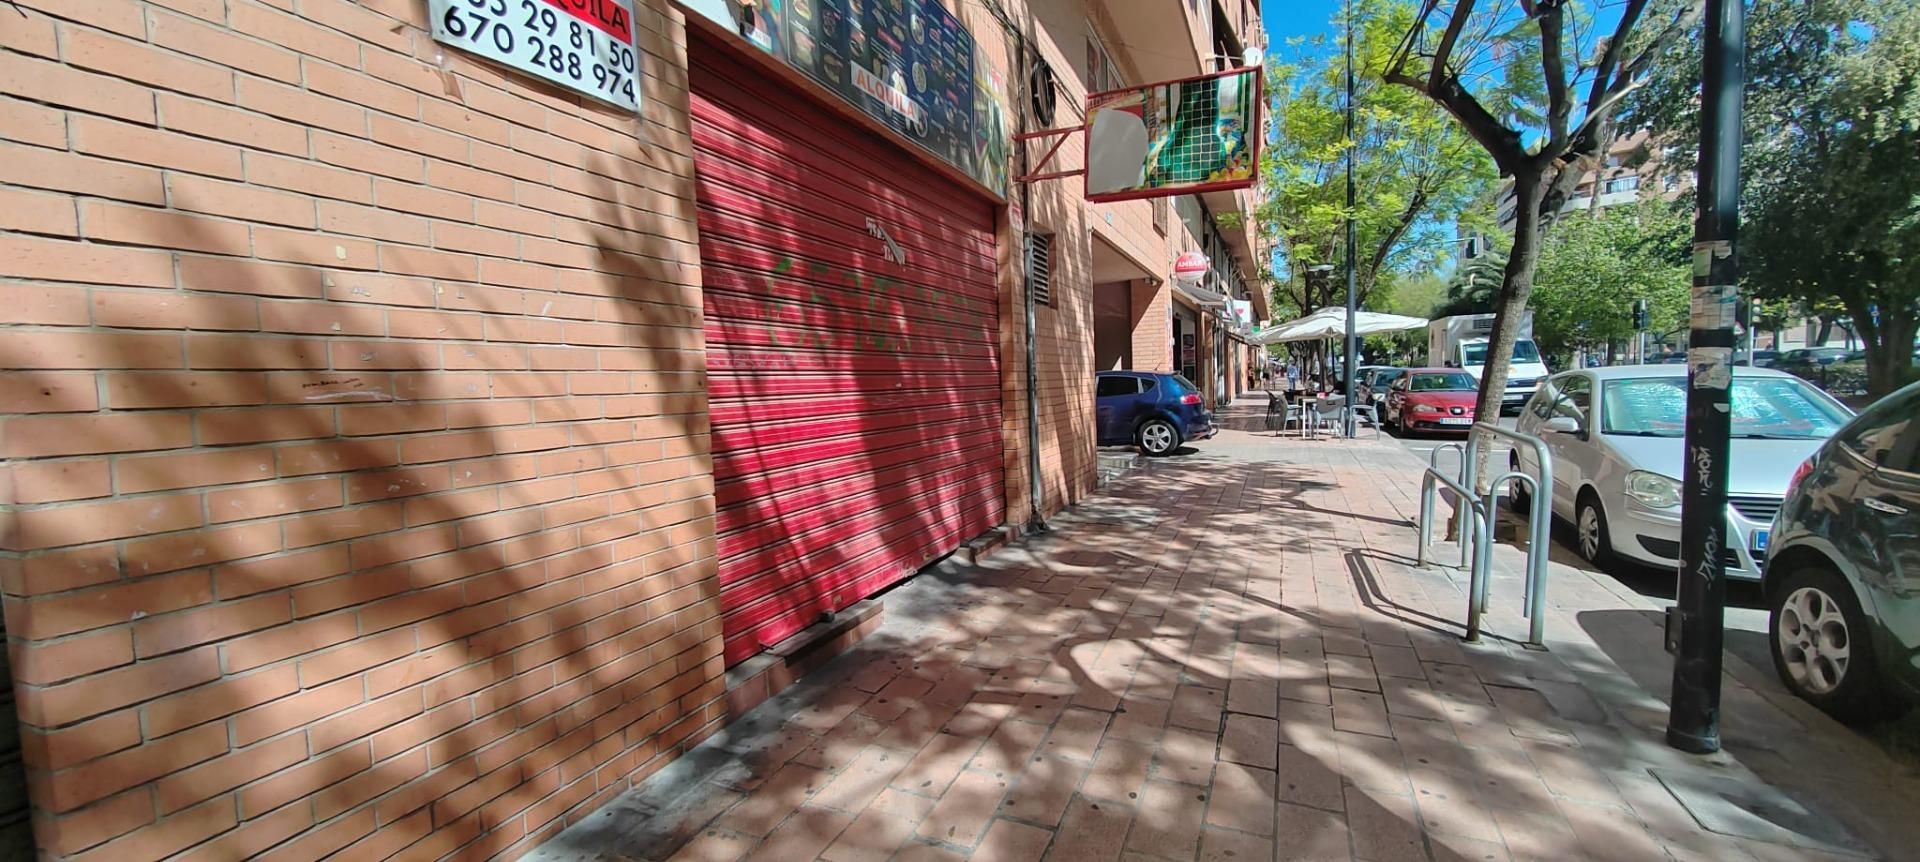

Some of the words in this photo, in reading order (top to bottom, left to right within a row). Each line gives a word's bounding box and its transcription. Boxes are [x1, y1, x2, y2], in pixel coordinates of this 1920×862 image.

[521, 0, 557, 37] 29
[569, 21, 595, 56] 81
[608, 40, 634, 73] 50
[556, 0, 627, 34] ILA
[444, 6, 514, 54] 670
[527, 36, 582, 80] 288
[592, 63, 635, 103] 974
[856, 68, 916, 119] ALQUILA
